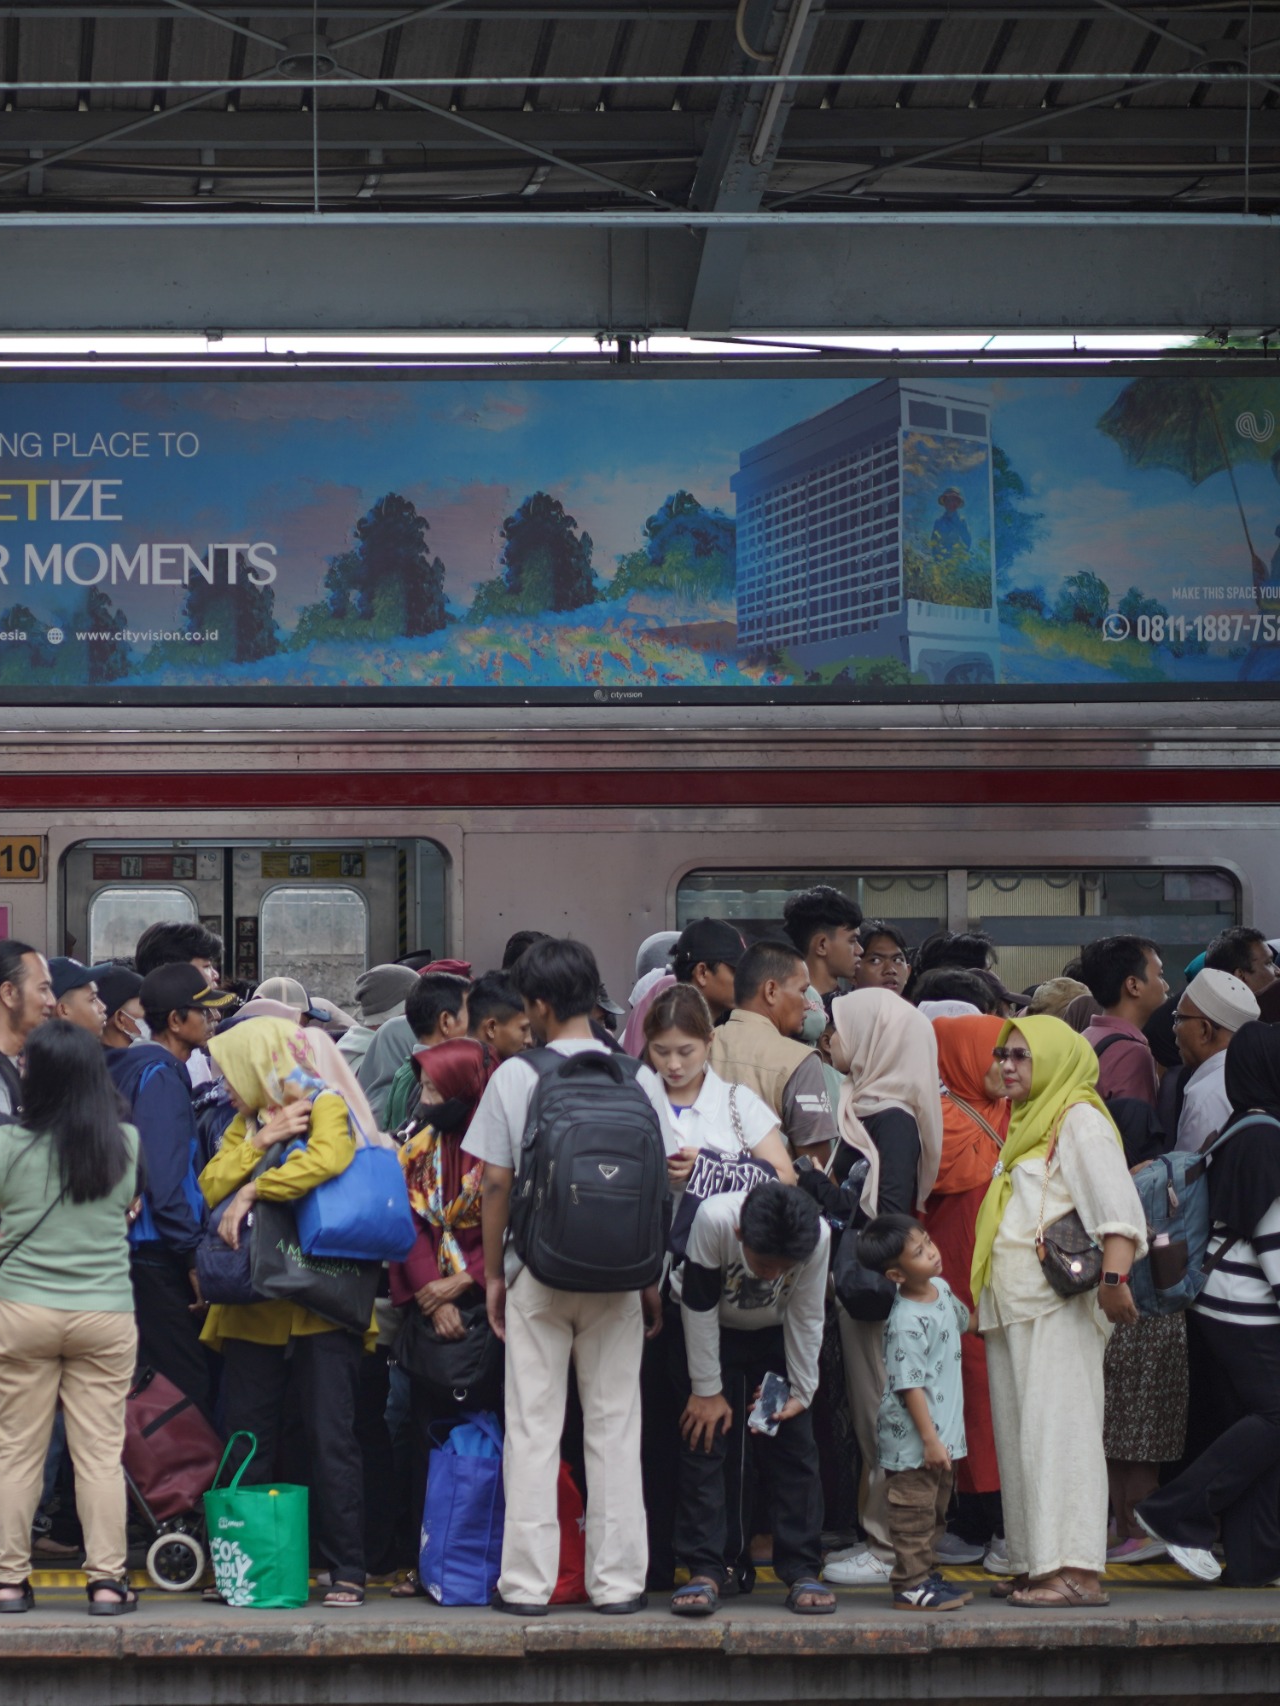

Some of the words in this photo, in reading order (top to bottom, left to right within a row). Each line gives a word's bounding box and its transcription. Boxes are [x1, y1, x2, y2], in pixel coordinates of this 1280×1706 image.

[53, 432, 150, 457] PLACE
[158, 432, 200, 458] TO
[24, 542, 278, 586] MOMENTS
[1172, 586, 1200, 600] MAKE
[1203, 586, 1225, 600] THIS
[1227, 586, 1257, 600] SPACE
[75, 628, 219, 642] www.cityvision.co.id
[610, 690, 643, 700] cityvision
[0, 844, 37, 872] 10
